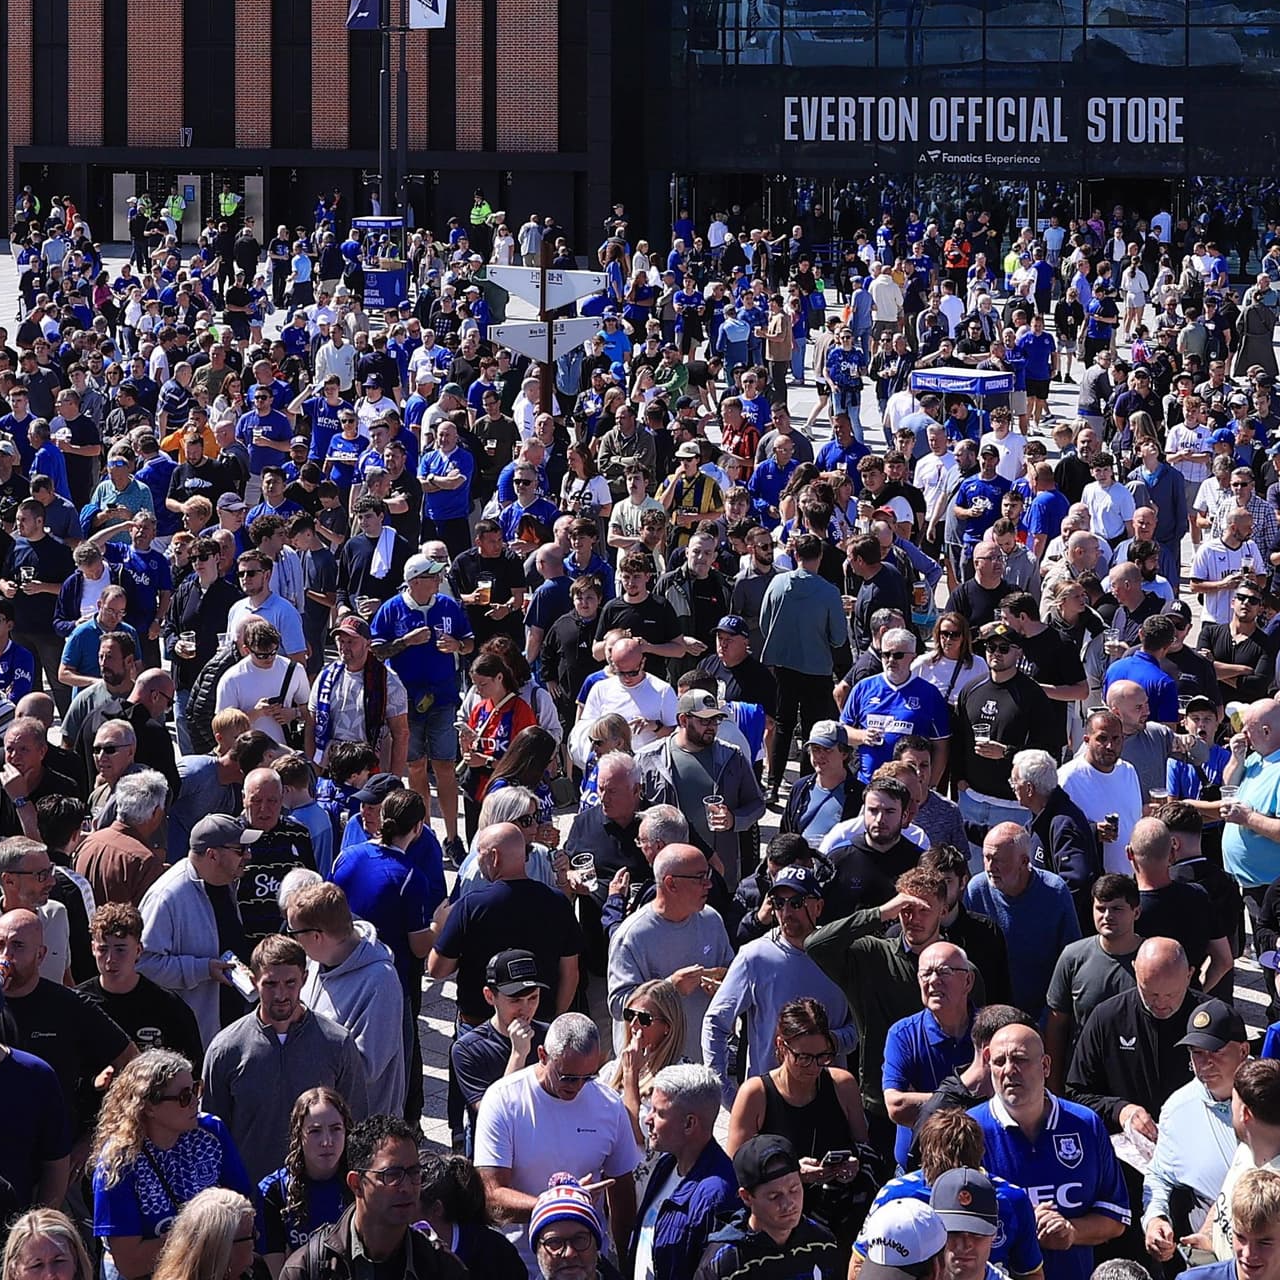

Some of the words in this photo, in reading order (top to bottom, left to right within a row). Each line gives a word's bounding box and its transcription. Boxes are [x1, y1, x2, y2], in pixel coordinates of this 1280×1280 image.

[784, 96, 918, 141] EVERTON
[929, 97, 1068, 142] OFFICIAL
[1087, 97, 1184, 143] STORE
[180, 128, 192, 147] 17
[919, 154, 927, 162] A
[942, 153, 983, 163] Fanatics
[985, 154, 1041, 165] Experience
[442, 617, 452, 634] 18
